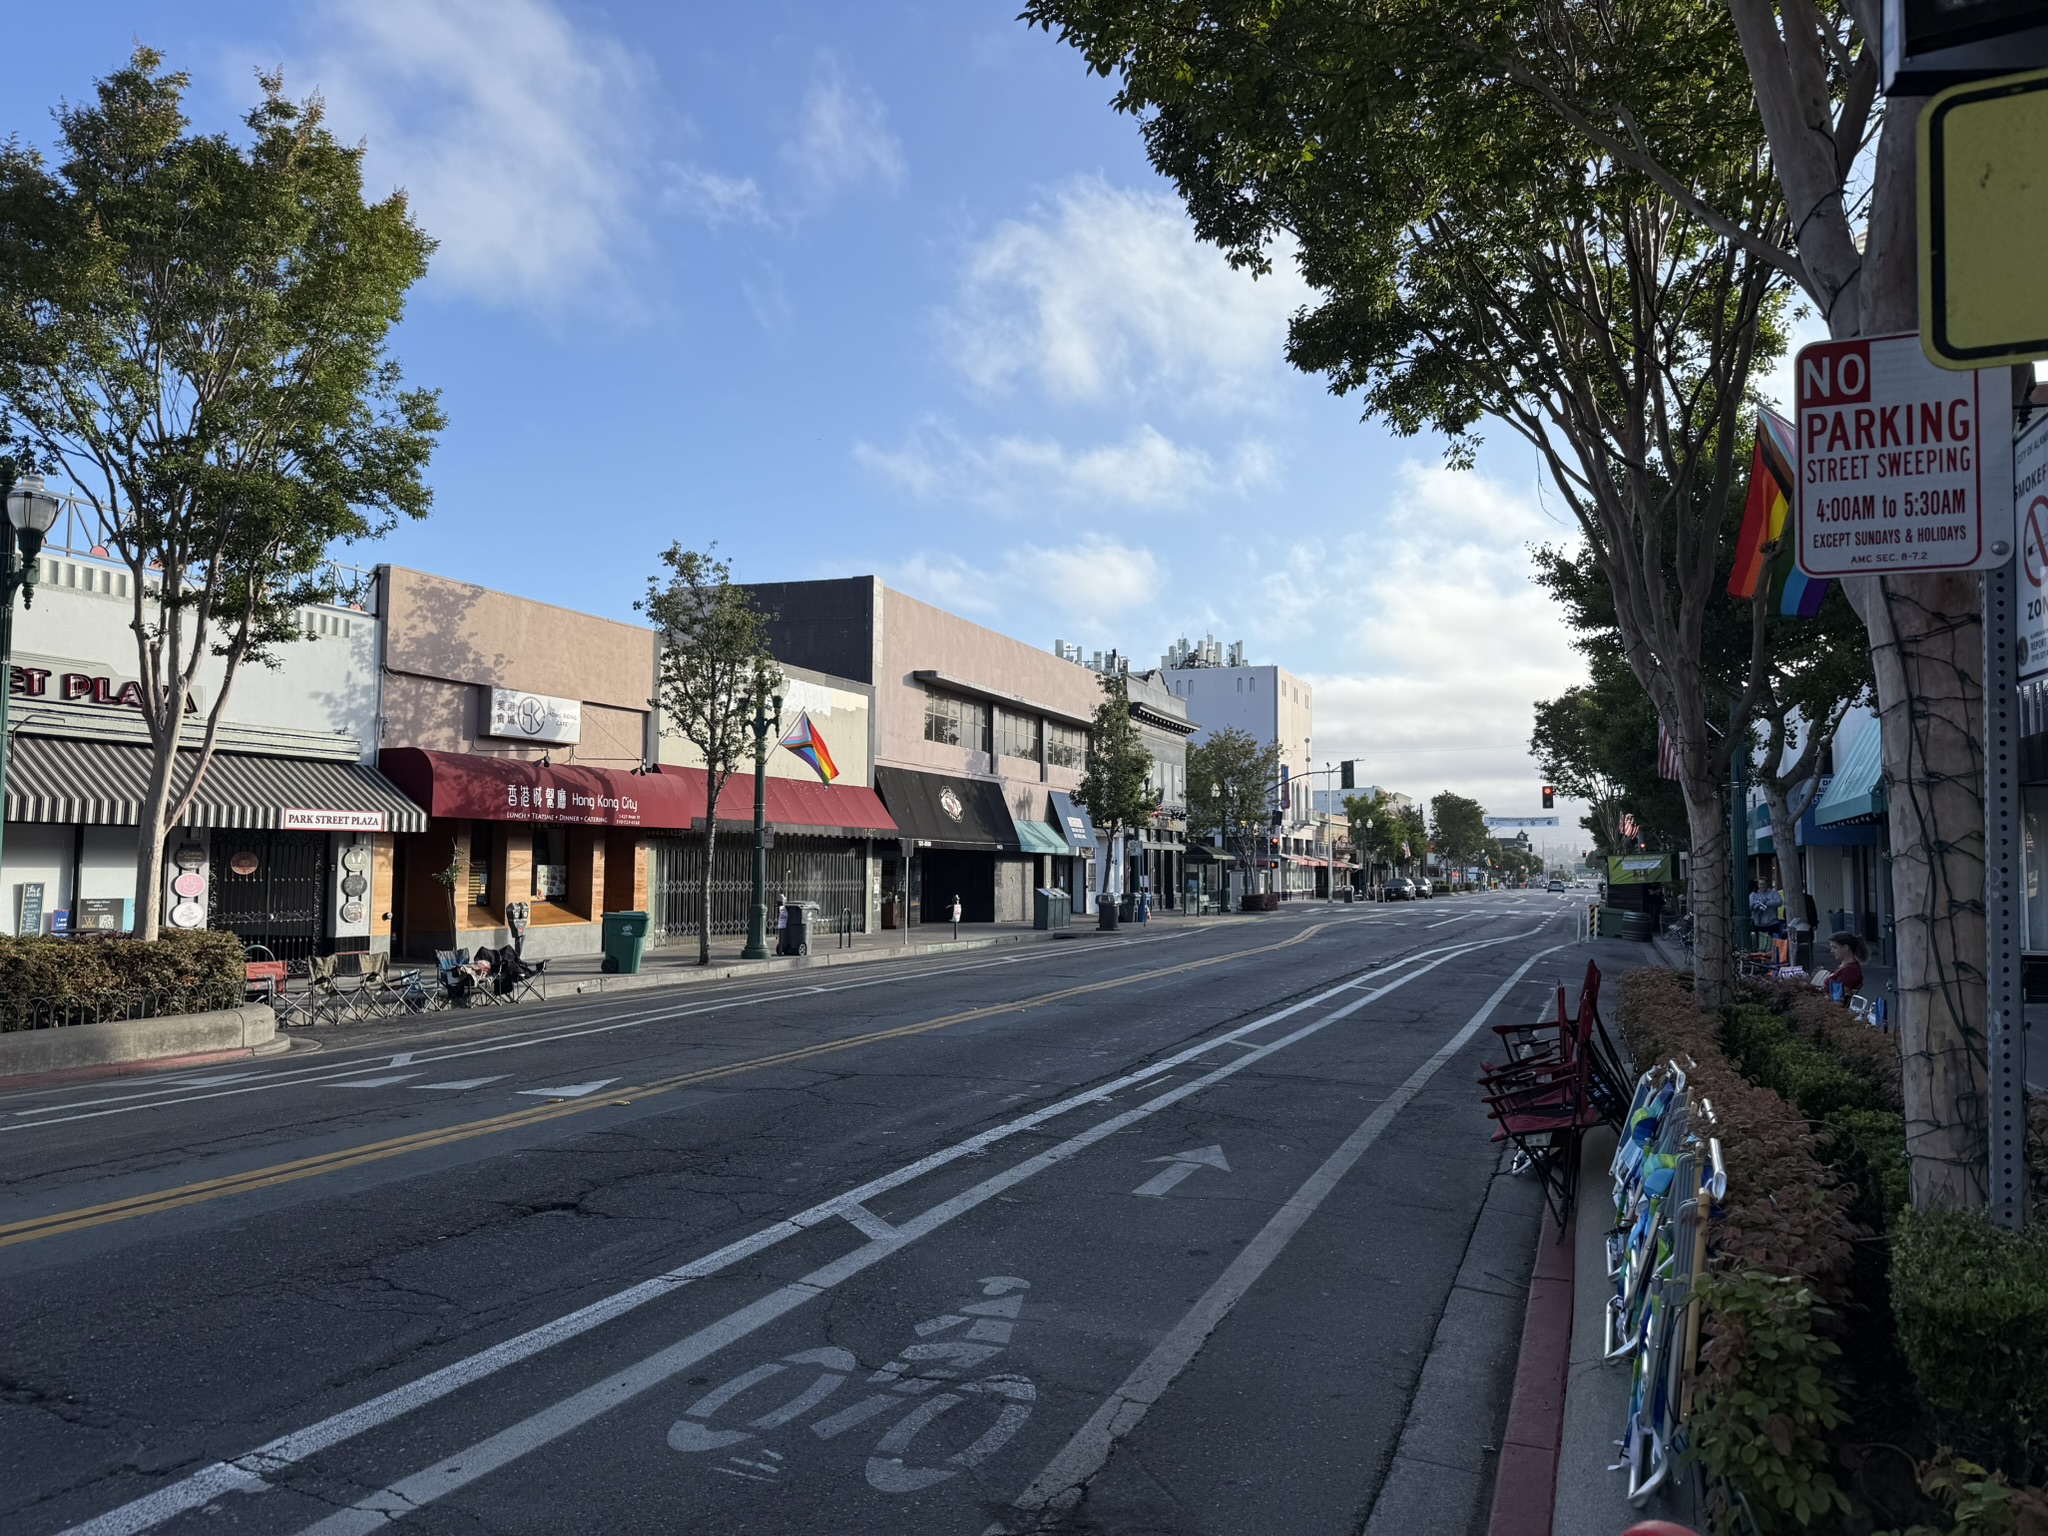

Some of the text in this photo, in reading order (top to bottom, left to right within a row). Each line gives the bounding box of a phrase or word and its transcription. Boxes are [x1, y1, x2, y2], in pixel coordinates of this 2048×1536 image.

[1803, 353, 1866, 401] NO
[1807, 398, 1970, 455] PARKING
[1807, 446, 1971, 485] STREET SWEEPING
[1816, 488, 1965, 523] 4:00AM to 5:30AM
[1813, 524, 1967, 550] EXCEPT SUNDAYS & HOLIDAYS
[1851, 551, 1928, 565] AMC SEC. 8-7.2
[547, 711, 562, 719] HONG
[572, 793, 595, 810] Hong
[597, 794, 619, 811] Kong
[621, 795, 638, 813] City
[288, 814, 379, 826] PARK STREET PLAZA
[506, 811, 526, 819] LUNCH
[531, 812, 554, 820] TEATIME
[559, 814, 580, 822] DINNER
